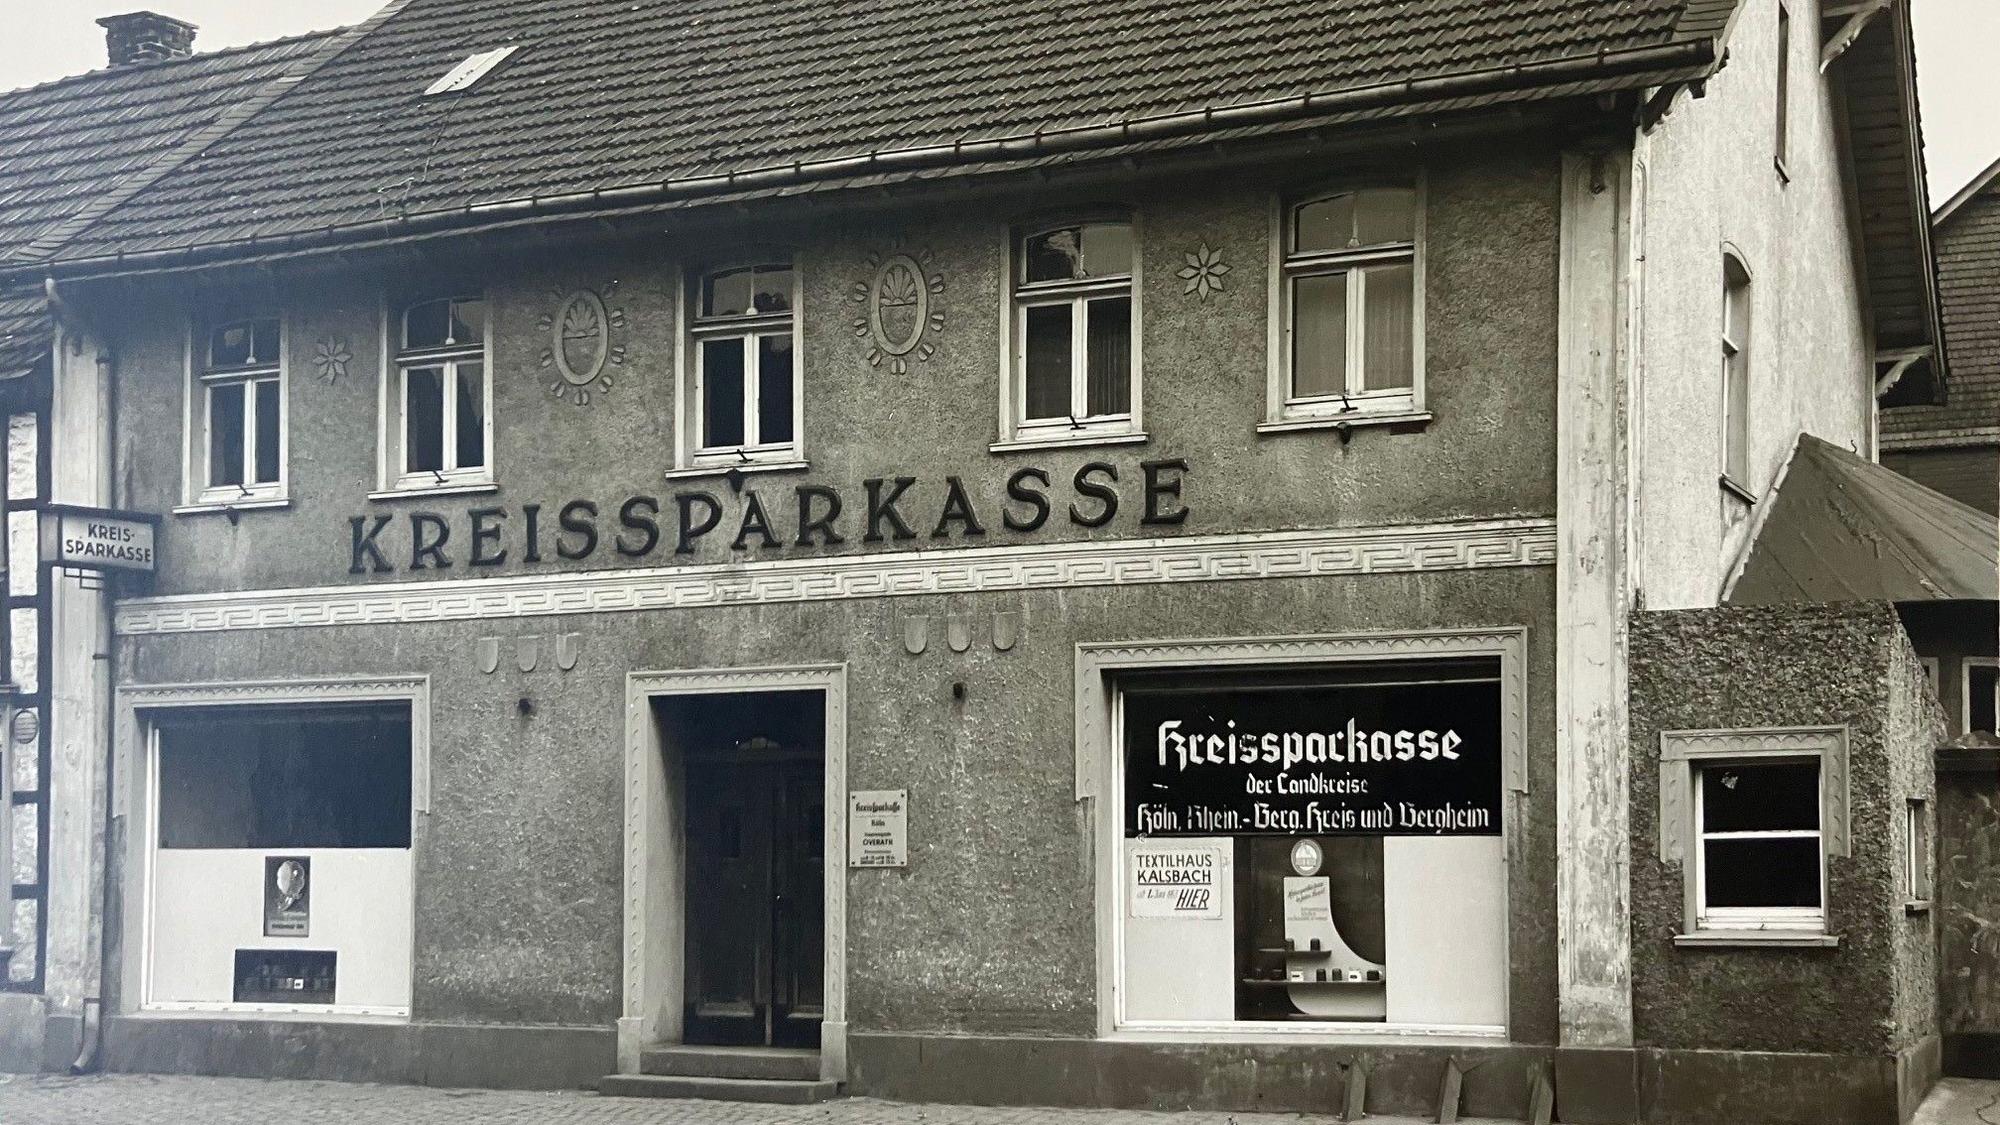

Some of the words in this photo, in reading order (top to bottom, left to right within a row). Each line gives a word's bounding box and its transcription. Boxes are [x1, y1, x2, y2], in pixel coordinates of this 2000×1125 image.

[347, 459, 1190, 575] KREISSPARKASSE
[88, 523, 135, 542] KREIS-
[66, 539, 151, 562] SPARKASSE
[1158, 717, 1462, 772] Kreissparkasse
[1245, 772, 1272, 795] der
[1276, 771, 1369, 795] Landkreise
[1306, 802, 1356, 834] Kreis
[1360, 802, 1393, 829] und
[1136, 854, 1212, 868] TEXTILHAUS
[1137, 869, 1212, 883] KALSBACH
[1176, 888, 1210, 908] HIER
